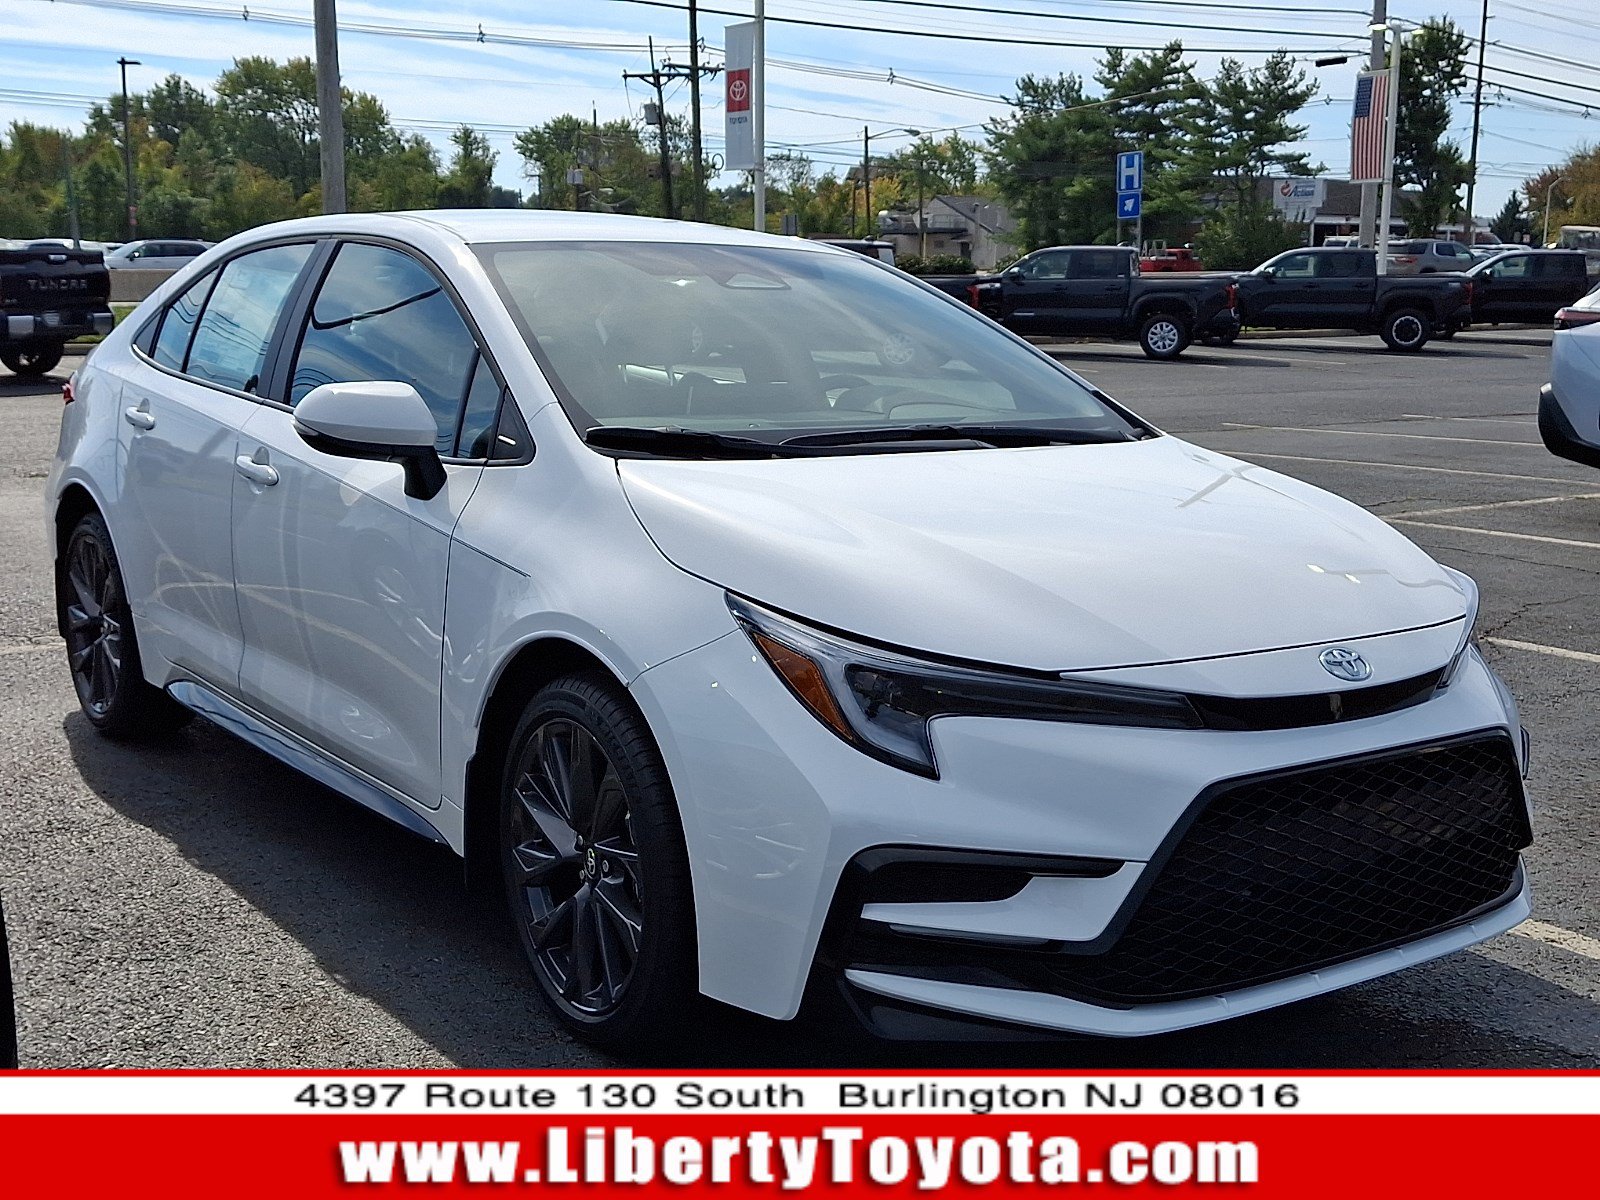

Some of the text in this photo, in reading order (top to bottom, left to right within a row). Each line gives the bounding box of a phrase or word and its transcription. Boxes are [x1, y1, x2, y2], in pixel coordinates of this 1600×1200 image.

[729, 116, 748, 125] TOYOTA
[1120, 154, 1139, 189] H
[28, 279, 88, 289] TUNDRA
